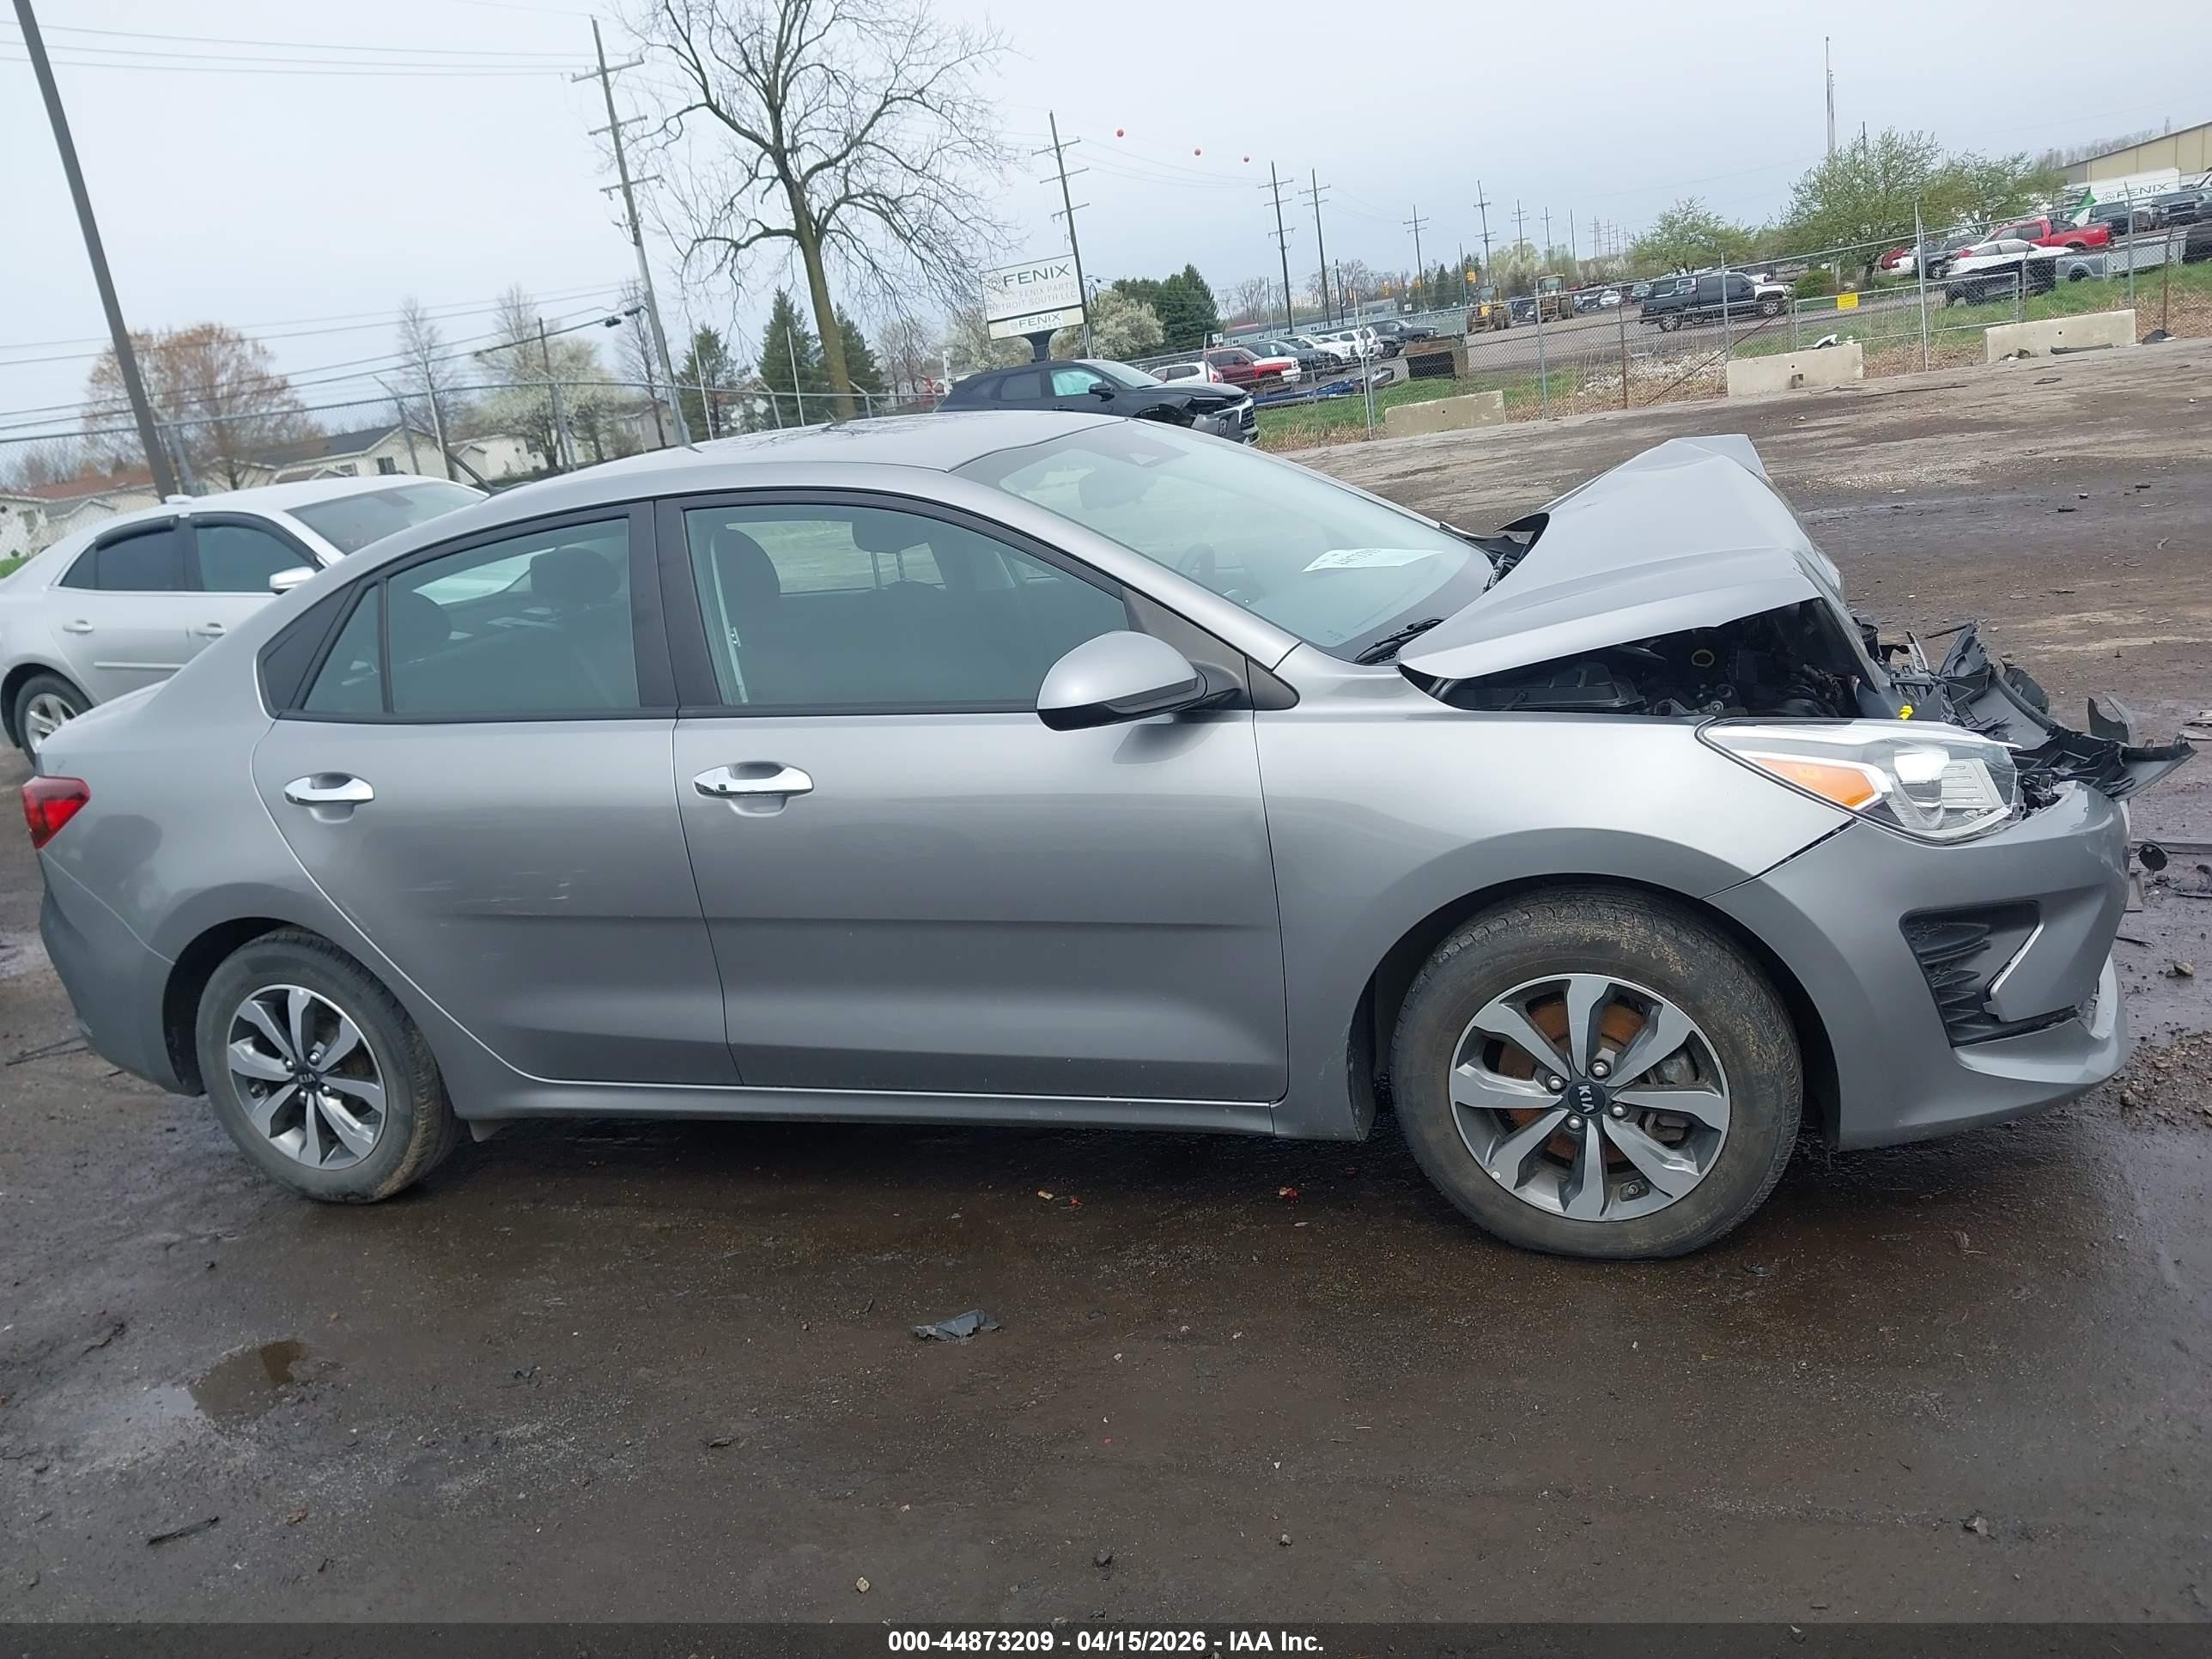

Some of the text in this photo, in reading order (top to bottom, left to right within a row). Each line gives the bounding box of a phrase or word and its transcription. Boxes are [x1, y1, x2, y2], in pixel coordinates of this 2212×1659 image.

[2117, 183, 2170, 199] FENIX
[1004, 264, 1070, 287] FENIX
[1019, 281, 1076, 298] FENIX PARTS
[1029, 295, 1059, 307] SOUTH
[1060, 290, 1077, 301] LLC
[1018, 313, 1062, 329] FENIX
[298, 1073, 316, 1083] KIA
[1578, 1085, 1595, 1113] KIA
